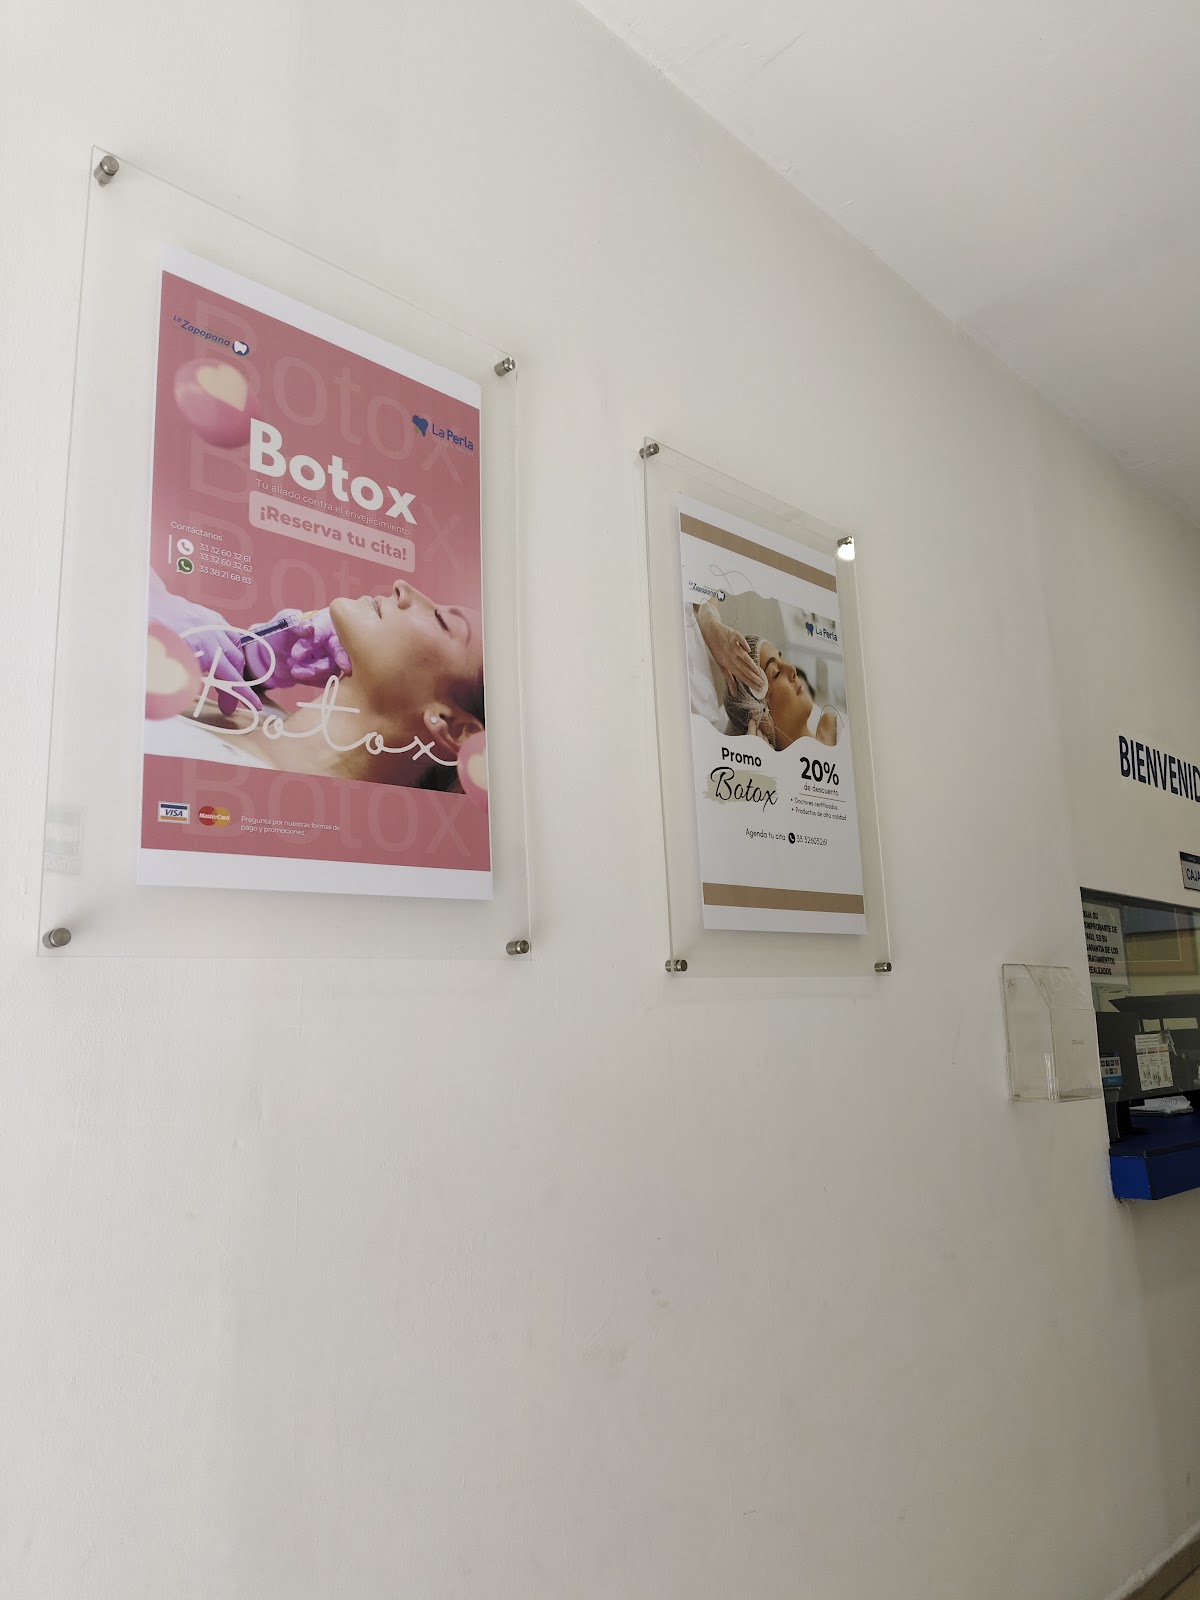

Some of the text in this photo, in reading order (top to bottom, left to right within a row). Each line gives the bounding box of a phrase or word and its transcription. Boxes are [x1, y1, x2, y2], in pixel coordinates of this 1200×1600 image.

[173, 315, 182, 323] La
[181, 320, 231, 346] Zapopana
[432, 422, 445, 438] La
[447, 428, 474, 451] Perla
[250, 417, 418, 526] Botox
[256, 478, 411, 536] Tu aliado contra el envejecimiento
[170, 521, 223, 542] Contáctanos
[260, 505, 407, 560] ¡Reserva tu cita!
[200, 542, 209, 552] 33
[210, 545, 220, 554] 32
[222, 550, 232, 558] 60
[232, 552, 242, 560] 32
[200, 552, 253, 572] 33 32 60 32 62
[199, 564, 252, 584] 33 38 21 68 83
[816, 626, 822, 636] La
[823, 628, 838, 642] Perla
[177, 625, 459, 766] Botox
[721, 746, 762, 768] Promo
[800, 756, 840, 786] 20%
[710, 766, 778, 812] Botox
[804, 782, 839, 796] de descuento
[164, 808, 183, 817] VISA
[198, 812, 230, 821] MasterCard
[796, 806, 816, 816] Productos
[240, 816, 272, 825] Pregunta
[284, 820, 311, 828] nuestras
[311, 822, 332, 830] formas
[240, 824, 258, 833] pago
[264, 827, 305, 836] promociones
[746, 828, 768, 838] Agenda
[1112, 925, 1118, 934] DE
